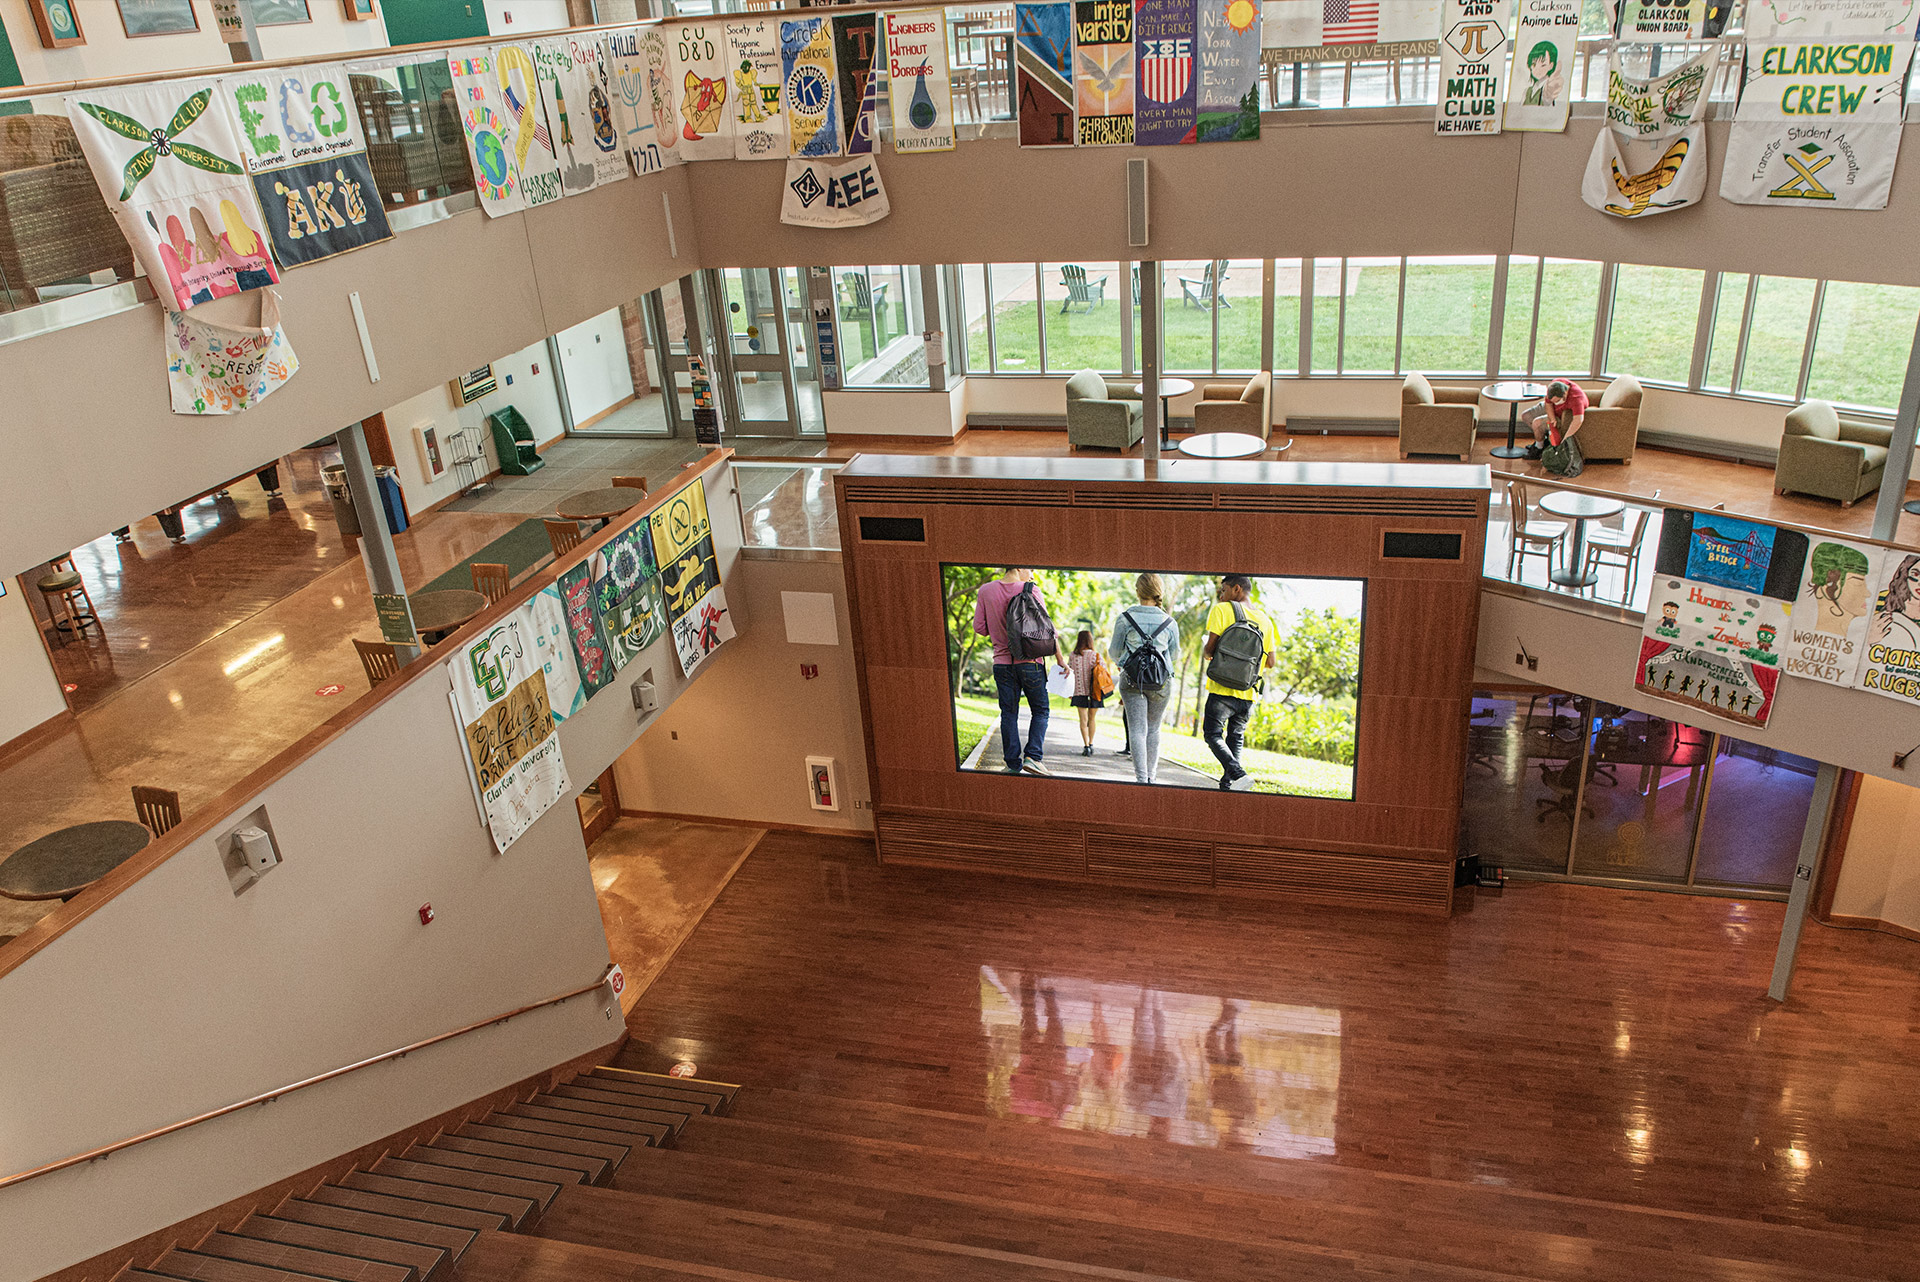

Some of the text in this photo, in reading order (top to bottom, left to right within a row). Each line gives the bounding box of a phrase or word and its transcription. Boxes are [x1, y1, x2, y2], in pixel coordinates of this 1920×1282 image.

[1146, 0, 1190, 11] ONE MAN
[1463, 4, 1493, 16] AND
[1530, 0, 1572, 12] Clarkson
[1836, 0, 1861, 10] Endure
[1140, 16, 1157, 24] CAN
[1161, 14, 1180, 22] MAKE
[1521, 13, 1578, 28] Anime Club
[1638, 9, 1690, 20] CLARKSON
[726, 21, 765, 36] Society of
[780, 19, 832, 43] Circle K
[1077, 18, 1132, 43] varsity
[1138, 22, 1193, 36] DIFFERENCE
[1636, 22, 1688, 33] UNION BOARD
[730, 38, 760, 50] Hispanic
[739, 48, 775, 59] Professional
[781, 46, 831, 61] International
[1263, 50, 1283, 62] WE
[1287, 48, 1330, 61] THANK
[1333, 46, 1361, 59] YOU
[1761, 44, 1894, 76] CLARKSON
[450, 56, 491, 77] ENGINEERS
[1456, 64, 1489, 76] JOIN
[467, 86, 486, 101] FOR
[1446, 77, 1497, 98] MATH
[1780, 84, 1868, 116] CREW
[173, 97, 205, 131] CLUB
[1139, 107, 1193, 119] EVERY MAN
[1444, 99, 1496, 117] CLUB
[99, 111, 148, 140] CLARKSON
[794, 118, 826, 129] service
[1079, 116, 1134, 132] CHRISTIAN
[1137, 118, 1193, 132] OUGHT TO TRY
[1438, 120, 1452, 132] WE
[1454, 120, 1481, 131] HAVE
[1079, 130, 1134, 145] FELLOWSHIP
[793, 139, 832, 154] leadership
[172, 144, 230, 172] UNIVERSITY
[1752, 127, 1860, 185] Transfer Student Association
[522, 170, 559, 196] CLARKSON
[530, 185, 558, 204] GUARD
[1706, 542, 1729, 554] STEEL
[1708, 552, 1738, 565] BRIDGE
[1689, 587, 1733, 611] Humans
[1712, 627, 1751, 649] Zombies
[1793, 630, 1854, 654] WOMEN'S
[1801, 647, 1838, 665] CLUB
[1787, 657, 1845, 682] HOCKEY
[1708, 671, 1748, 687] ACAPELLA
[519, 737, 557, 773] University
